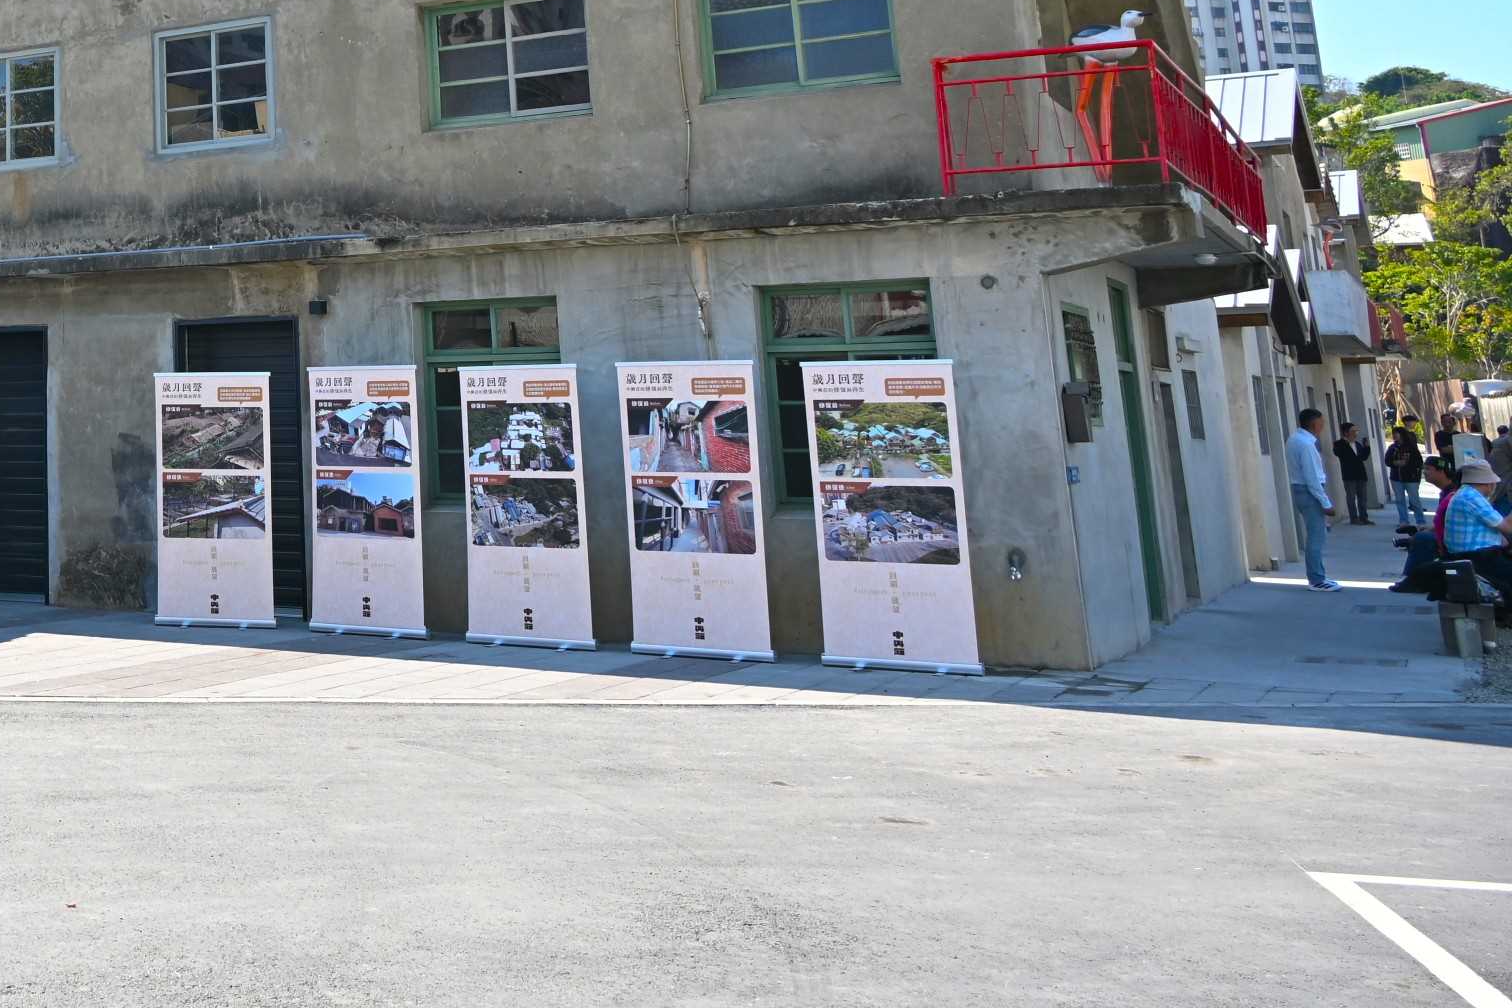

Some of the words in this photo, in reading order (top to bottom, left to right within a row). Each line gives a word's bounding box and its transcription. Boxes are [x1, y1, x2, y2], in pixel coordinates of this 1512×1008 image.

[315, 377, 353, 387] 歲月回聲
[467, 376, 507, 387] 歲月回聲
[626, 373, 673, 384] 歲月回聲
[812, 373, 864, 385] 歲月回聲
[161, 382, 202, 392] 歲月回聲
